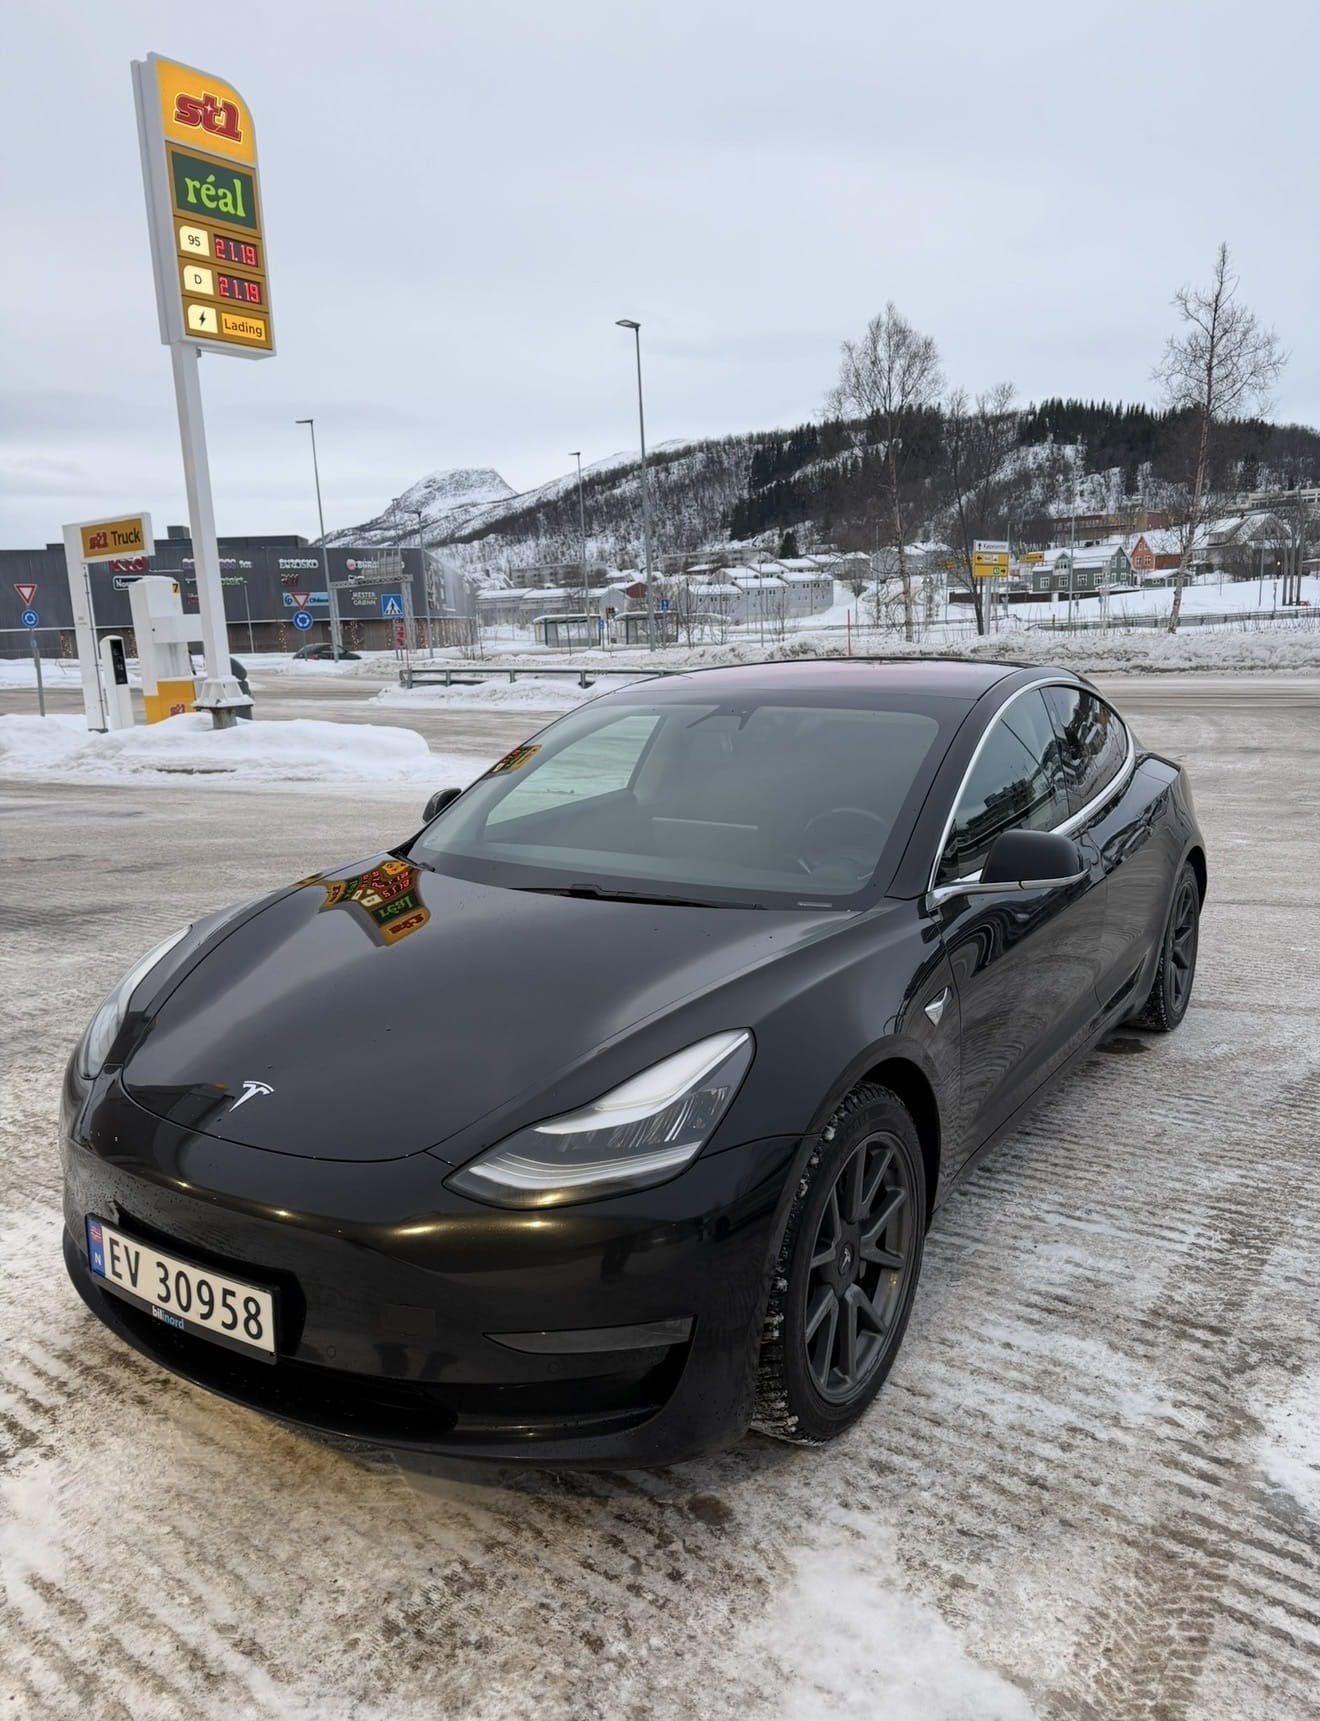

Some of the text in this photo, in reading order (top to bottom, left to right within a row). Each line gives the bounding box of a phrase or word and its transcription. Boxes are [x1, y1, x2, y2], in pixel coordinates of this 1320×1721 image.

[174, 92, 243, 143] st1
[185, 174, 246, 217] réal
[187, 234, 257, 266] 95 21.19
[194, 274, 260, 303] D 21.19
[224, 318, 263, 337] Lading
[110, 527, 141, 546] Truck
[172, 583, 179, 593] 7
[94, 1251, 102, 1266] N
[109, 1237, 263, 1340] EV 30958
